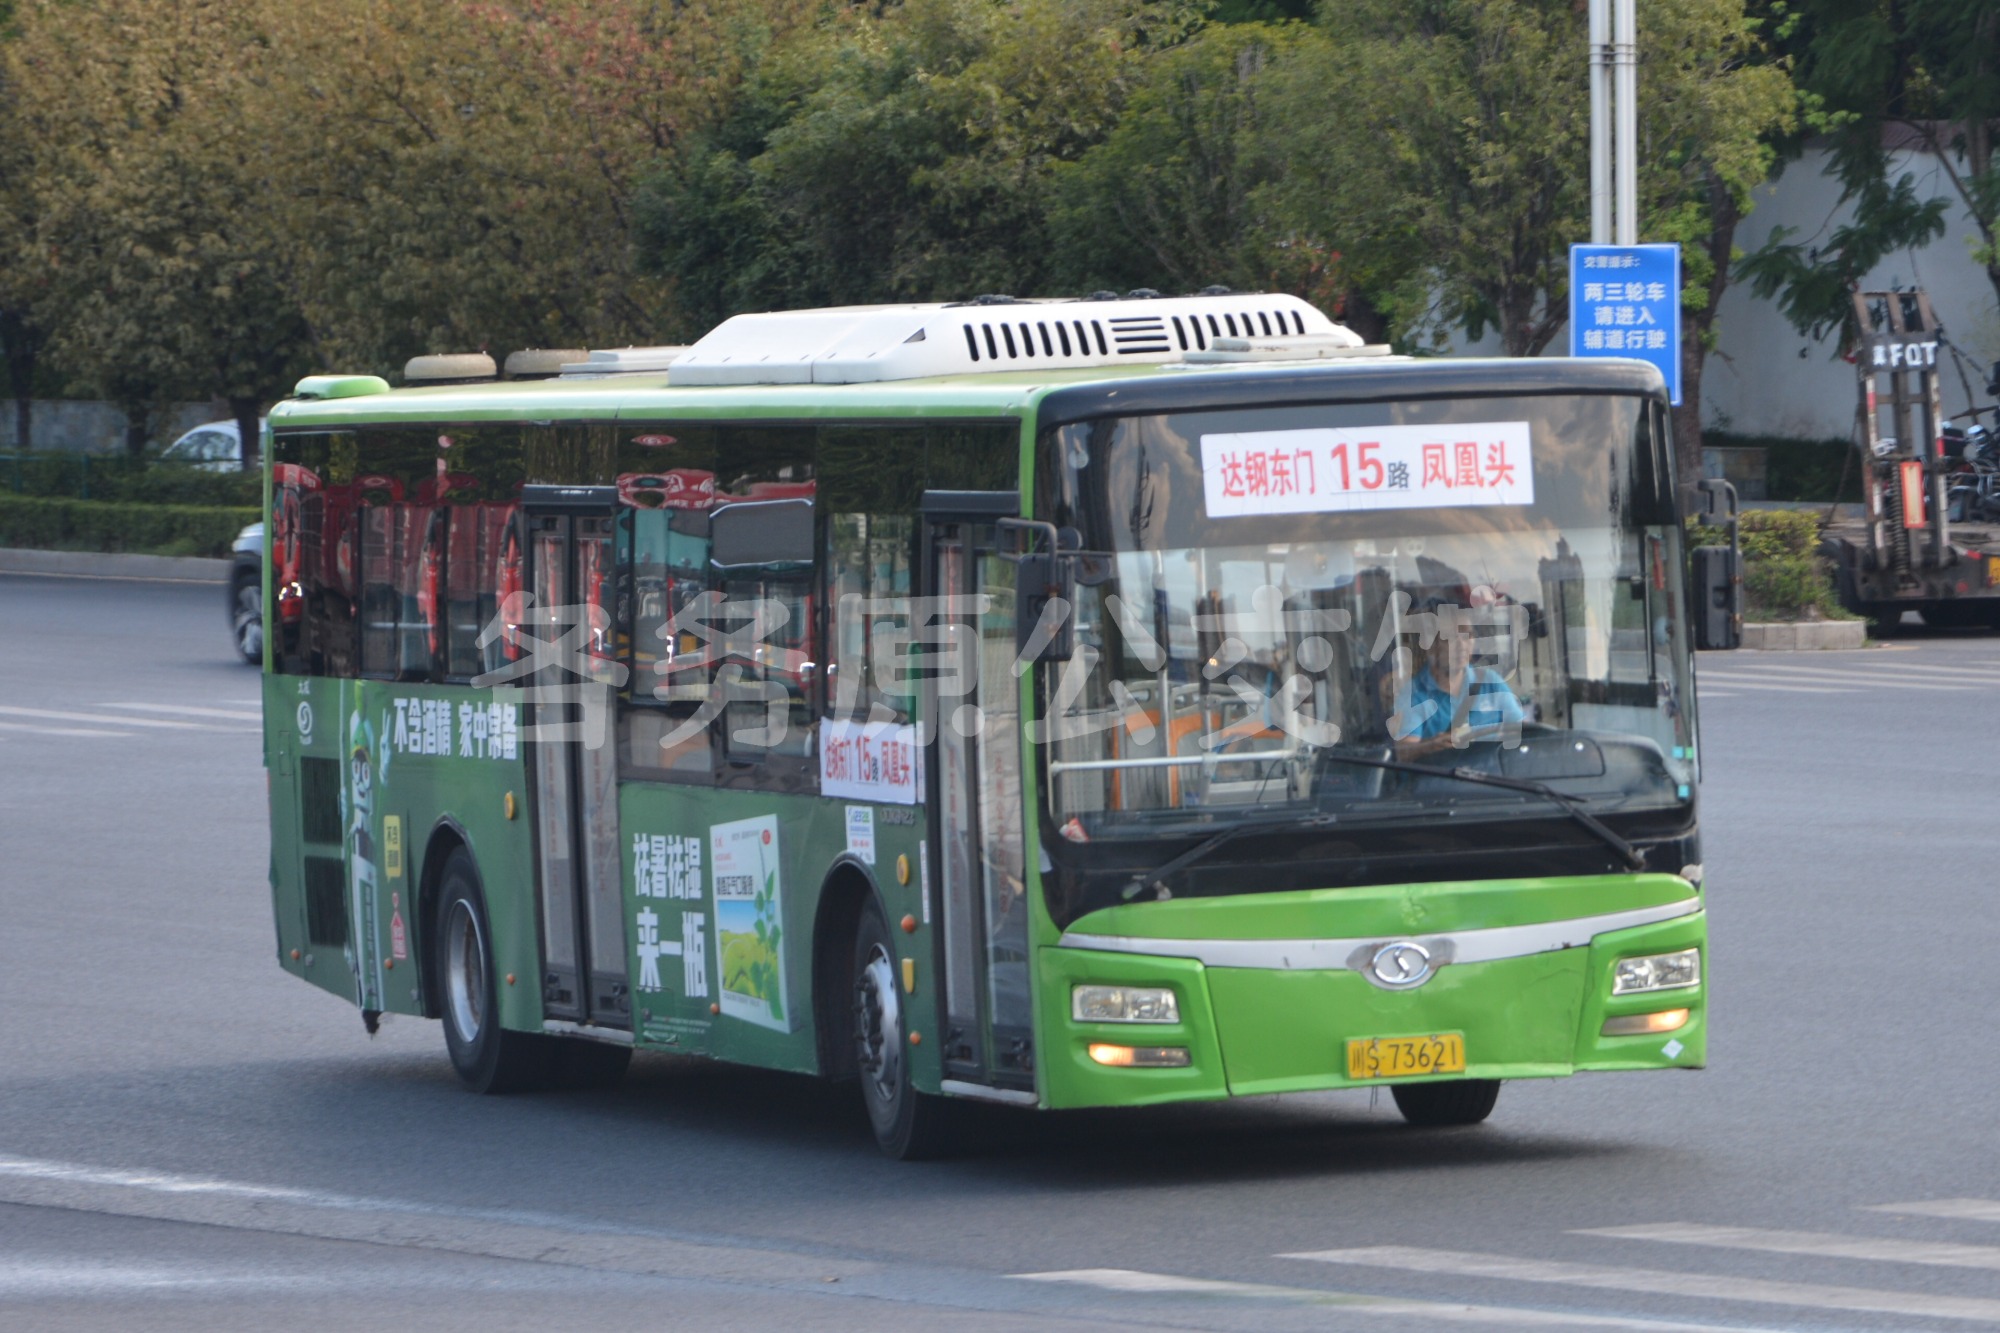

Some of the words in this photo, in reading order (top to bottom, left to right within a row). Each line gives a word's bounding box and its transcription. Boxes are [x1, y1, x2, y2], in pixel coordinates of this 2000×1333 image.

[1584, 282, 1666, 302] 两三轮车
[1595, 306, 1656, 325] 请进入
[1584, 329, 1667, 349] 辅道行驶
[1220, 447, 1316, 498] 达钢东门
[1331, 442, 1411, 490] 15路
[1421, 441, 1516, 489] 凤凰头
[393, 698, 452, 755] 不含酒精
[459, 701, 518, 760] 家中常备
[633, 832, 702, 899] 祛暑祛湿
[636, 906, 708, 997] 来一瓶
